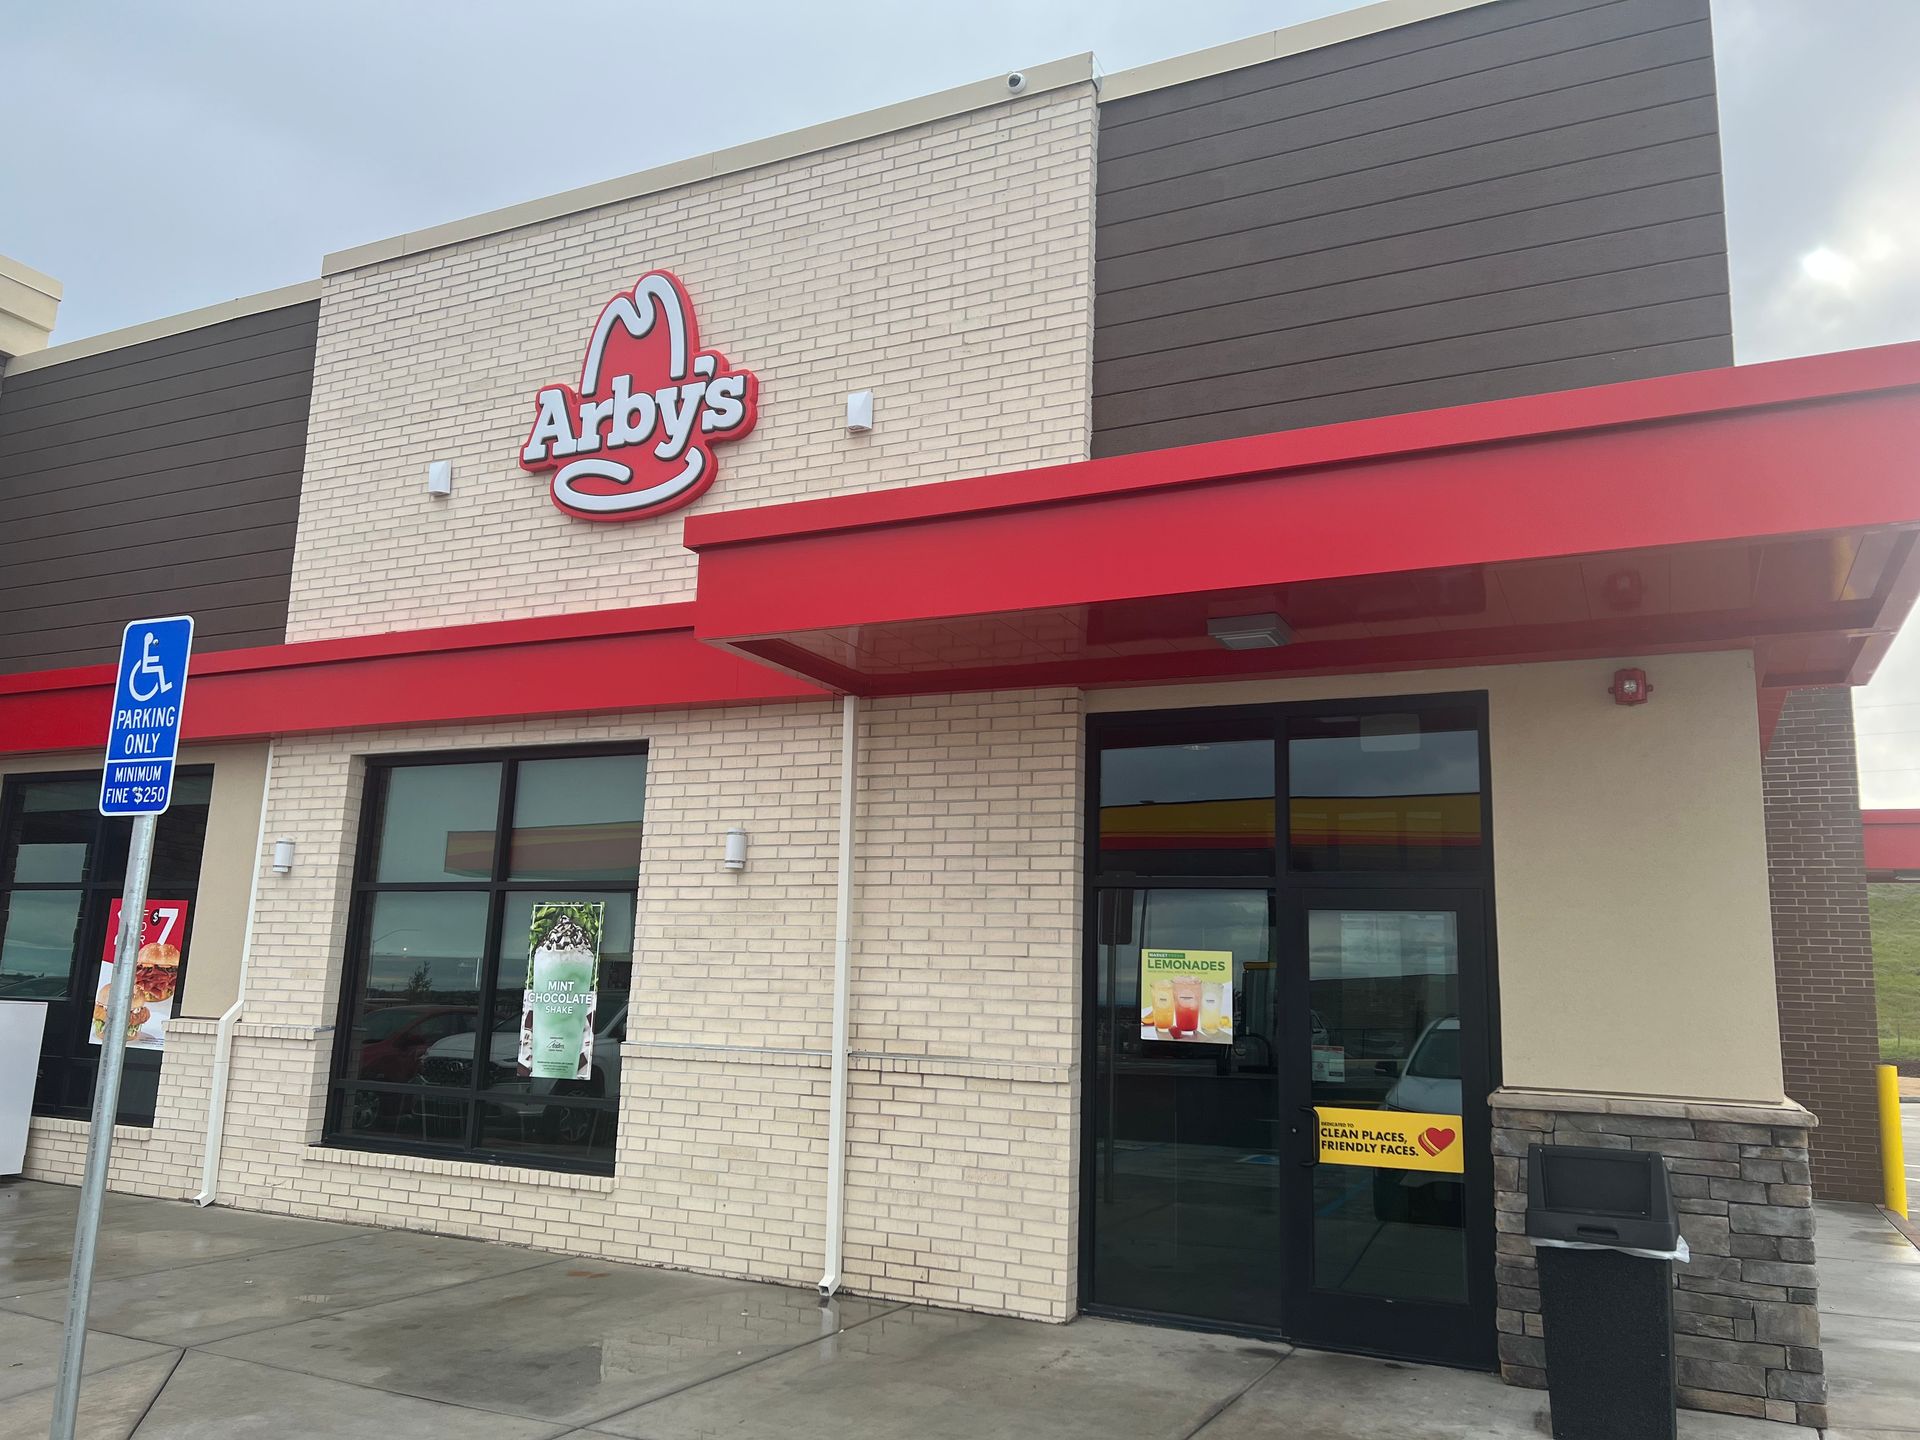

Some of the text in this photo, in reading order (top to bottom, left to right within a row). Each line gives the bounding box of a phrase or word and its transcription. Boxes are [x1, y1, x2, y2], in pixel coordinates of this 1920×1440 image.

[523, 355, 746, 461] Arby's
[116, 706, 175, 730] PARKING
[124, 733, 160, 755] ONLY
[114, 765, 162, 783] MINIMUM
[105, 785, 165, 805] FINE $250
[1147, 959, 1226, 971] LEMONADES
[547, 981, 575, 991] MINT
[528, 992, 592, 1004] CHOCOLATE
[545, 1005, 573, 1014] SHAKE
[1320, 1127, 1407, 1144] CLEAN PLACES,
[1321, 1140, 1419, 1156] FRIENDLY FACES.
